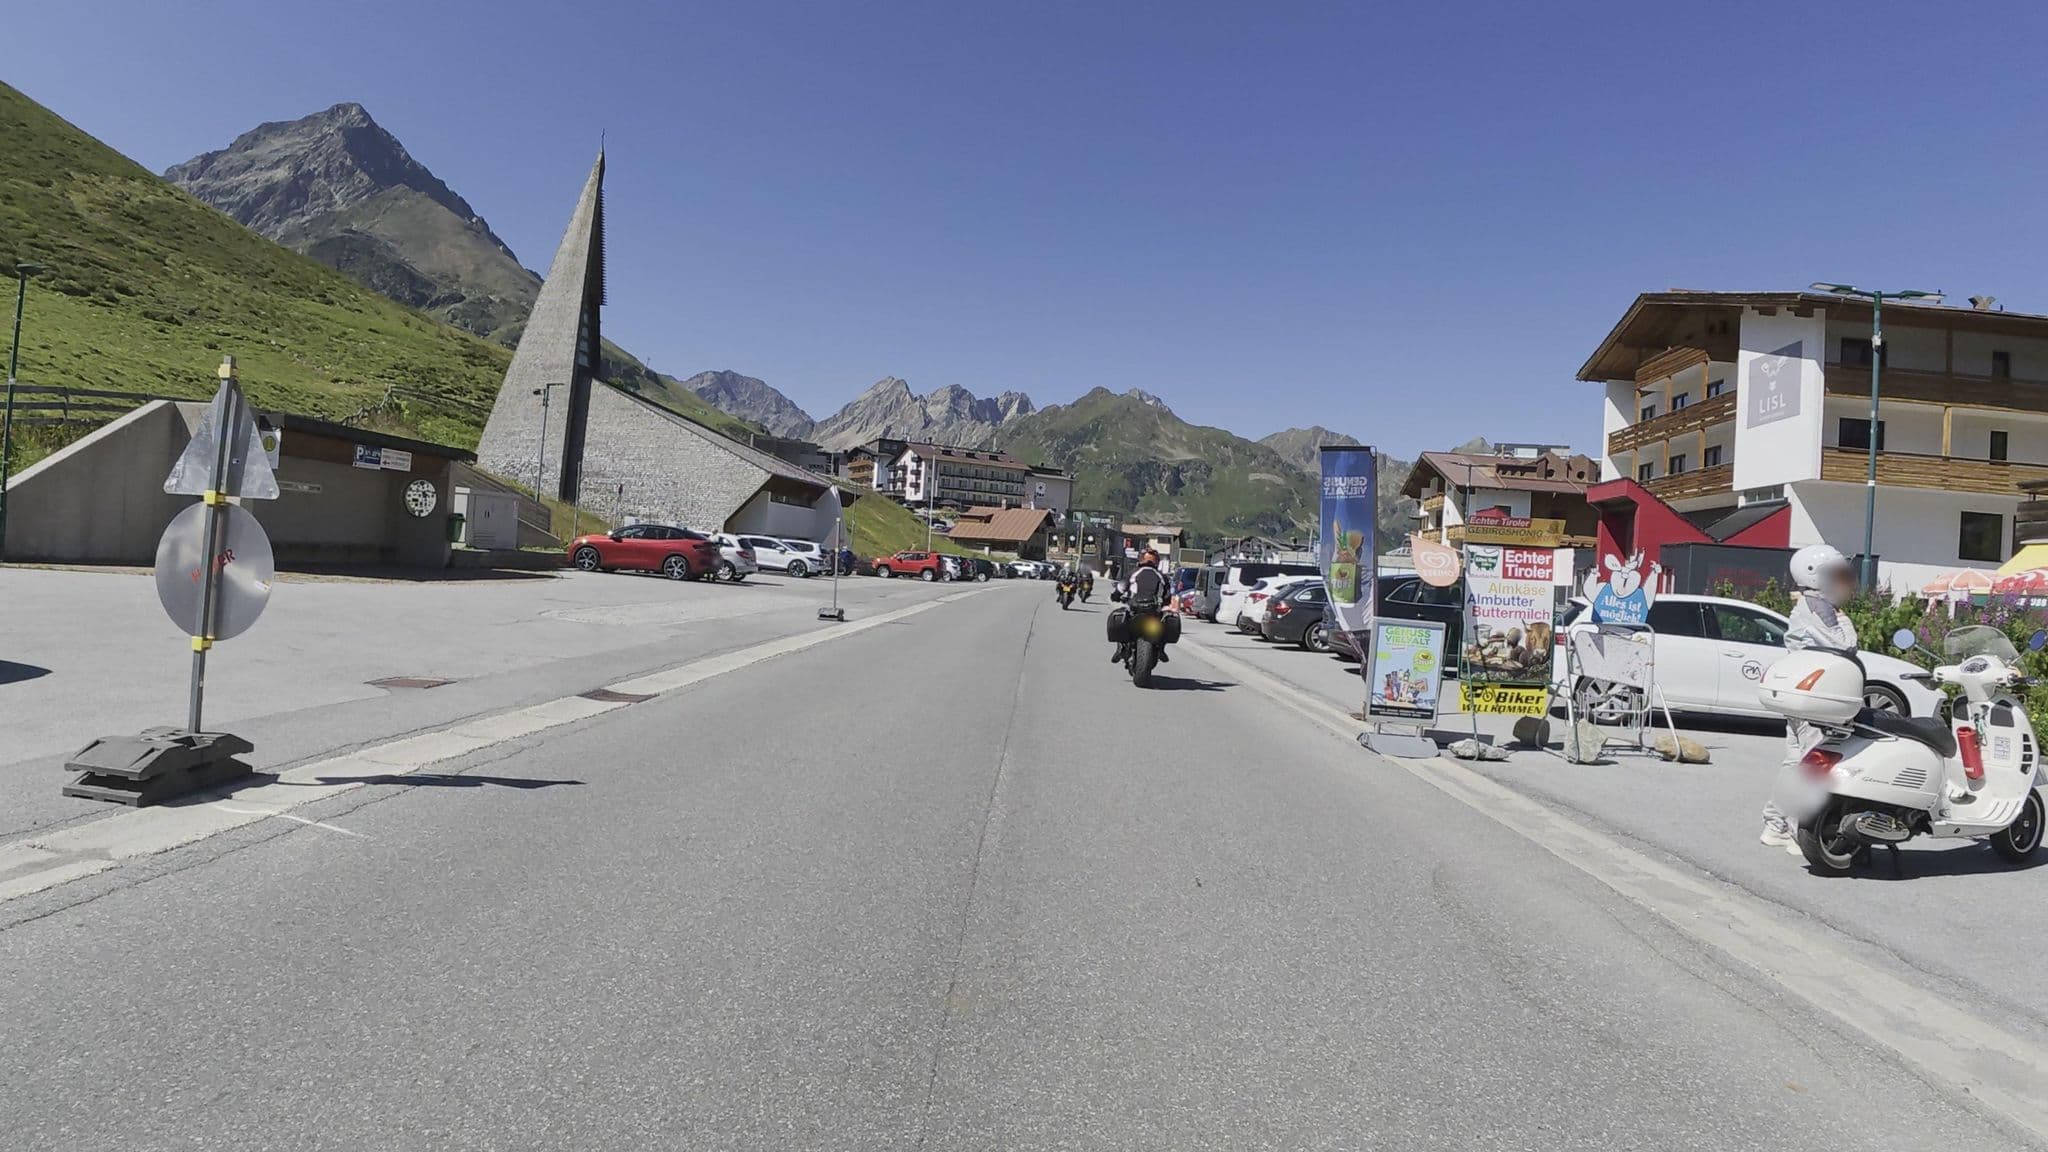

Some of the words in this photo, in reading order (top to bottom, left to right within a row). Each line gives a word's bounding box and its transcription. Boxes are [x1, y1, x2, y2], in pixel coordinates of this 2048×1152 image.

[1759, 393, 1786, 414] LISL
[1469, 516, 1498, 525] Echter
[1501, 518, 1530, 527] Tiroler
[1504, 550, 1552, 565] Echter
[1505, 564, 1552, 579] Tiroler
[1488, 582, 1546, 597] Almkäse
[1467, 593, 1535, 608] Almbutter
[1600, 595, 1626, 609] Alles
[1628, 600, 1642, 613] ist
[1472, 605, 1550, 621] Buttermilch
[1385, 626, 1432, 639] GENUSS
[1384, 635, 1431, 646] VIELFALT
[1495, 691, 1544, 705] Biker
[1461, 704, 1543, 714] WILLKOMMEN
